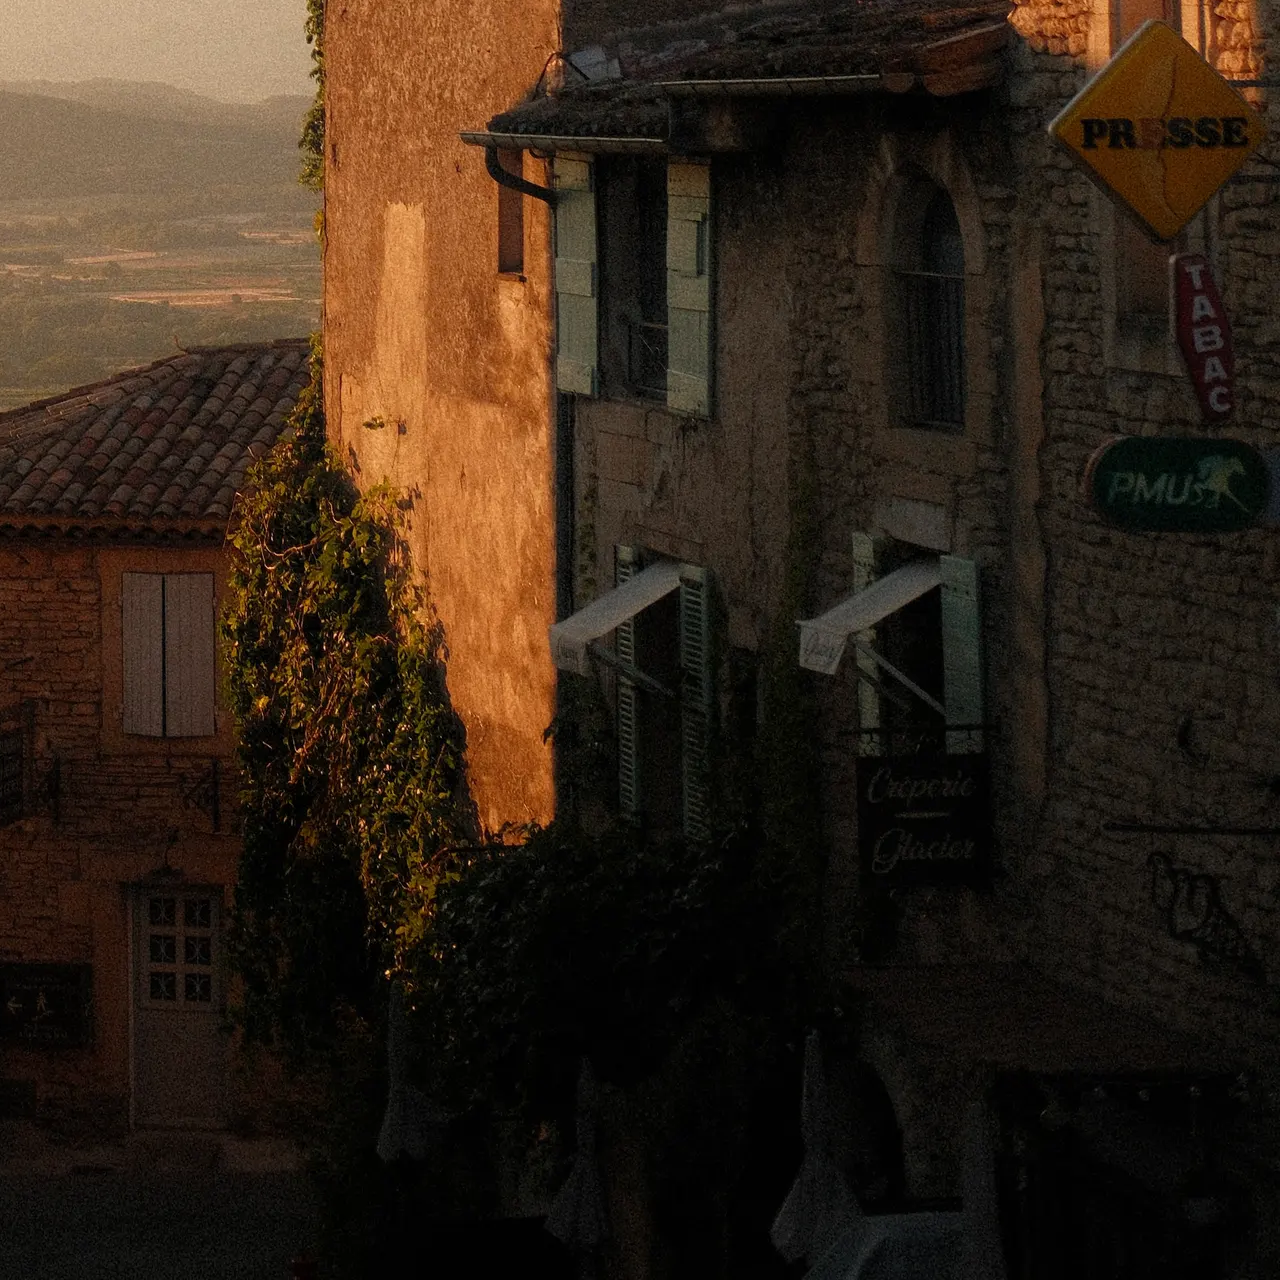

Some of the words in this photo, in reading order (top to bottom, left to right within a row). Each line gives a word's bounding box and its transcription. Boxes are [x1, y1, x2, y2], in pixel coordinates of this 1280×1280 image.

[1080, 115, 1249, 150] PRESSE
[1184, 263, 1232, 414] TABAC
[1106, 471, 1195, 506] PMU
[871, 826, 977, 874] Glacier
